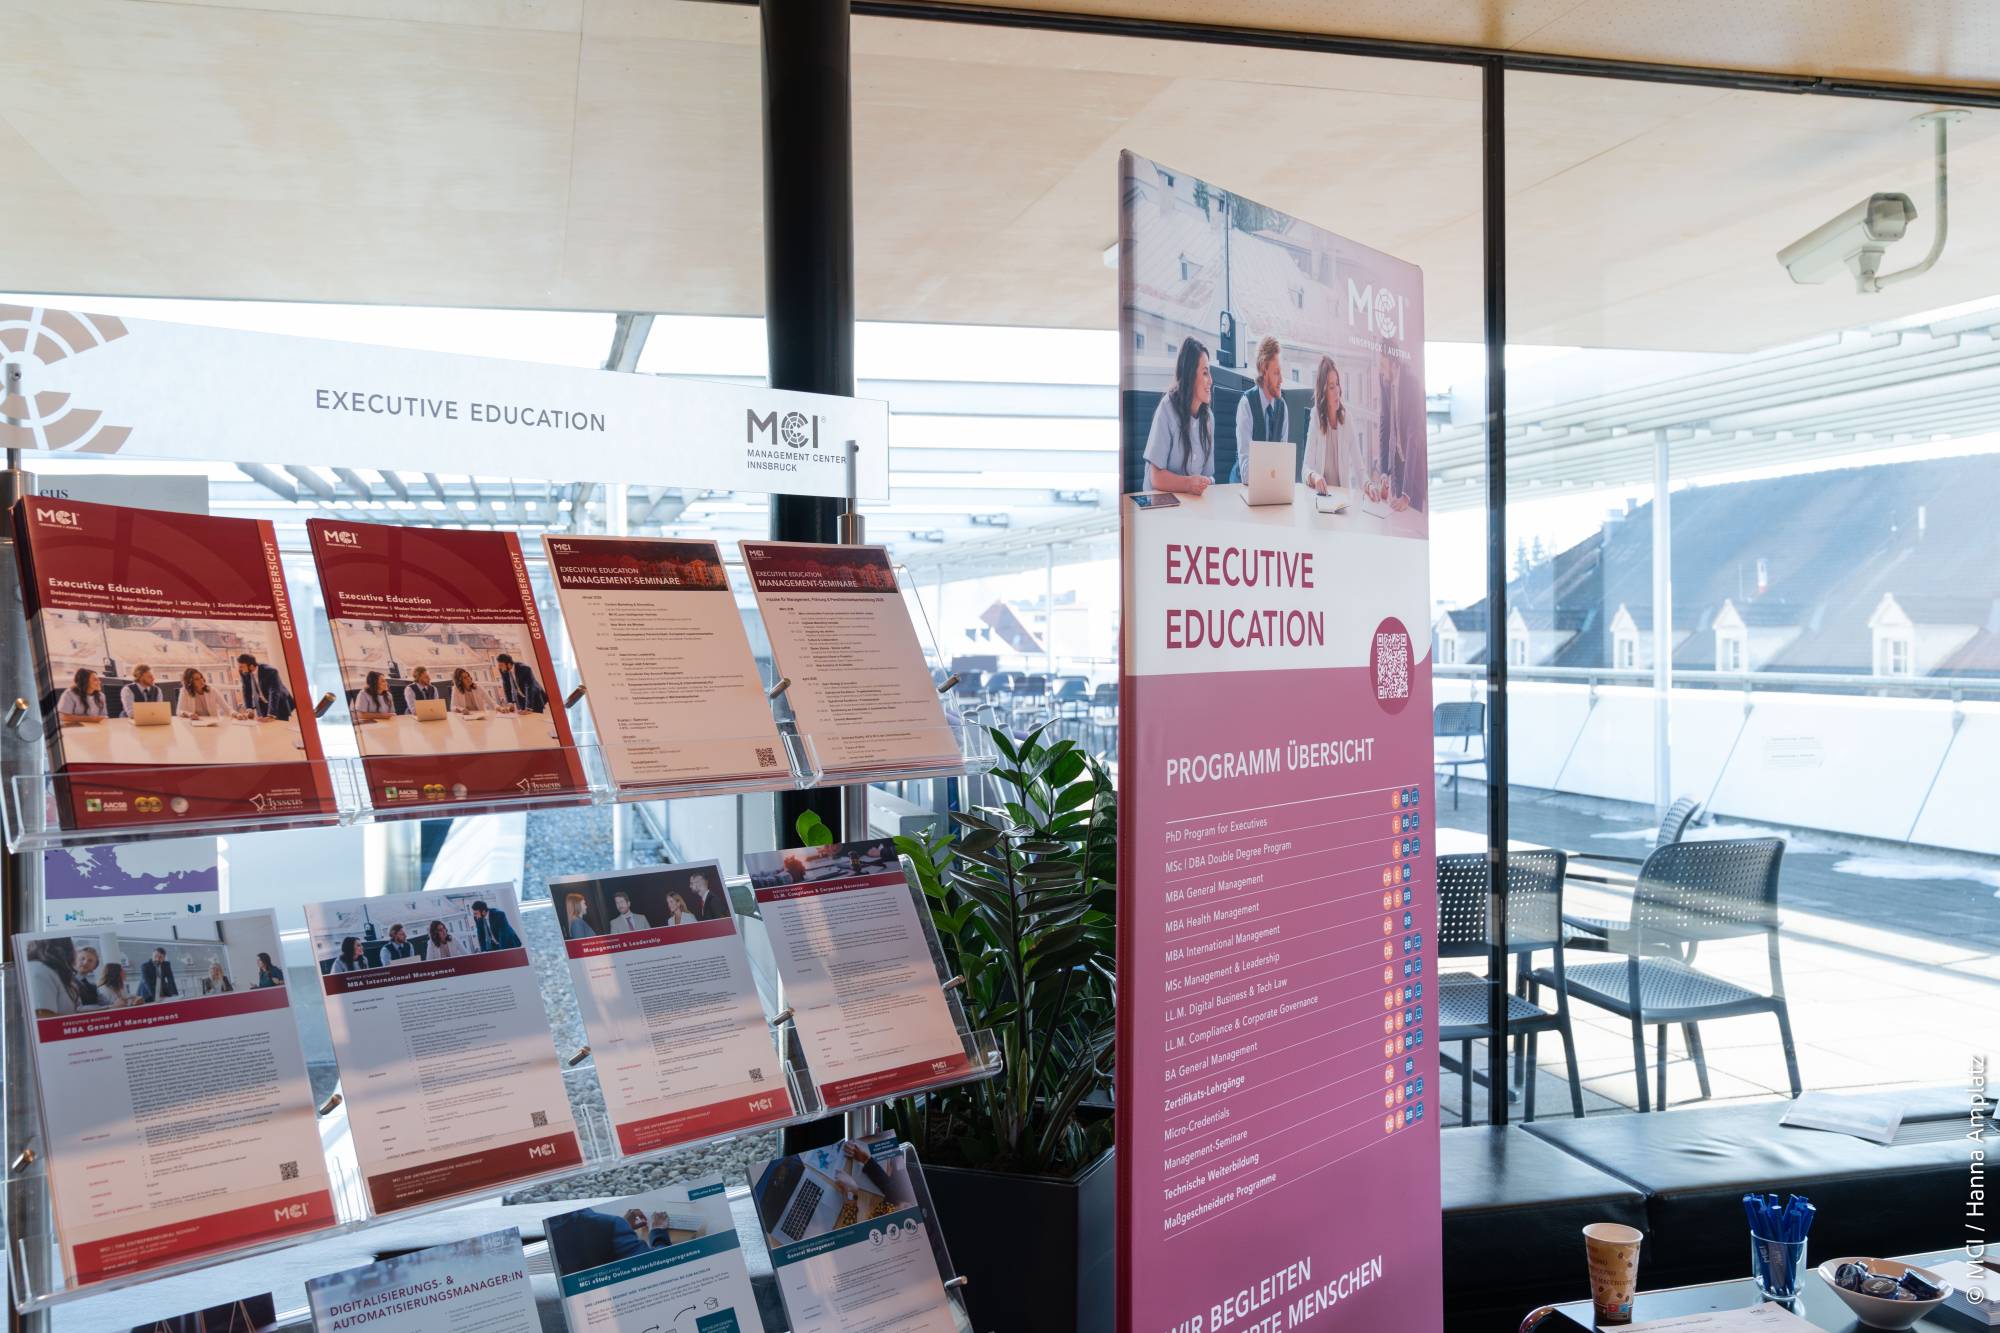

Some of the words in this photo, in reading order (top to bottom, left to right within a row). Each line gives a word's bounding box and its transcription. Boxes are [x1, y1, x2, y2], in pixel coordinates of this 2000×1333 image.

[316, 389, 459, 421] EXECUTIVE
[470, 403, 606, 432] EDUCATION
[747, 449, 810, 462] MANAGEMENT
[812, 454, 848, 464] CENTER
[747, 460, 798, 472] INNSBRUCK
[559, 566, 598, 574] EXECUTIVE
[598, 567, 639, 575] EDUCATION
[562, 575, 681, 586] MANAGEMENT-SEMINARE
[758, 579, 859, 588] MANAGEMENT-SEMINARE
[1166, 543, 1314, 588] EXECUTIVE
[48, 577, 105, 591] Executive
[108, 583, 164, 596] Education
[263, 541, 293, 639] GESAMTÜBERSICHT
[338, 591, 384, 602] Executive
[386, 594, 432, 605] Education
[511, 551, 542, 640] GESAMTÜBERSICHT
[1166, 608, 1325, 649] EDUCATION
[1166, 747, 1281, 786] PROGRAMM
[1286, 738, 1375, 771] ÜBERSICHT
[1165, 830, 1182, 844] PhD
[1183, 826, 1216, 842] Program
[1217, 824, 1229, 835] for
[1230, 817, 1268, 832] Executives
[1165, 862, 1183, 873] MSc
[1189, 856, 1206, 868] DBA
[1207, 851, 1234, 866] Double
[1236, 848, 1262, 862] Degree
[1263, 840, 1292, 856] Program
[1165, 890, 1184, 903] MBA
[1186, 885, 1216, 901] General
[1217, 873, 1264, 892] Management
[1165, 920, 1184, 933] MBA
[1186, 914, 1211, 928] Health
[1213, 902, 1260, 922] Management
[583, 942, 622, 954] Management
[629, 936, 661, 950] Leadership
[1165, 950, 1184, 963] MBA
[1186, 938, 1234, 958] International
[1235, 924, 1281, 944] Management
[366, 973, 411, 986] International
[412, 967, 456, 980] Management
[1165, 980, 1182, 993] MSc
[1184, 965, 1233, 987] Management
[1234, 961, 1240, 972] &
[1242, 952, 1280, 971] Leadership
[1165, 1007, 1187, 1022] LL.M.
[1189, 999, 1214, 1015] Digital
[1216, 990, 1247, 1006] Business
[1249, 985, 1255, 997] &
[1256, 980, 1273, 994] Tech
[1274, 977, 1288, 989] Law
[63, 1026, 84, 1035] MBA
[86, 1020, 122, 1033] General
[124, 1013, 180, 1026] Management
[1165, 1036, 1187, 1052] LL.M.
[1189, 1022, 1233, 1046] Compliance
[1234, 1018, 1240, 1030] &
[1242, 1007, 1278, 1027] Corporate
[1279, 994, 1319, 1013] Governance
[1165, 1069, 1177, 1081] BA
[1178, 1059, 1209, 1077] General
[1210, 1042, 1258, 1066] Management
[1164, 1074, 1245, 1112] Zertifikats-Lehrgänge
[1164, 1107, 1230, 1141] Micro-Credentials
[1164, 1130, 1248, 1171] Management-Seminare
[1164, 1176, 1206, 1201] Technische
[1207, 1152, 1260, 1181] Weiterbildung
[1164, 1191, 1234, 1231] Maßgeschneiderte
[1236, 1172, 1277, 1198] Programme
[329, 1279, 442, 1317] DIGITALISIERUNGS-
[446, 1275, 455, 1284] &
[333, 1270, 524, 1331] AUTOMATISIERUNGSMANAGER:IN
[1210, 1256, 1312, 1333] BEGLEITEN
[1288, 1255, 1382, 1330] MENSCHEN
